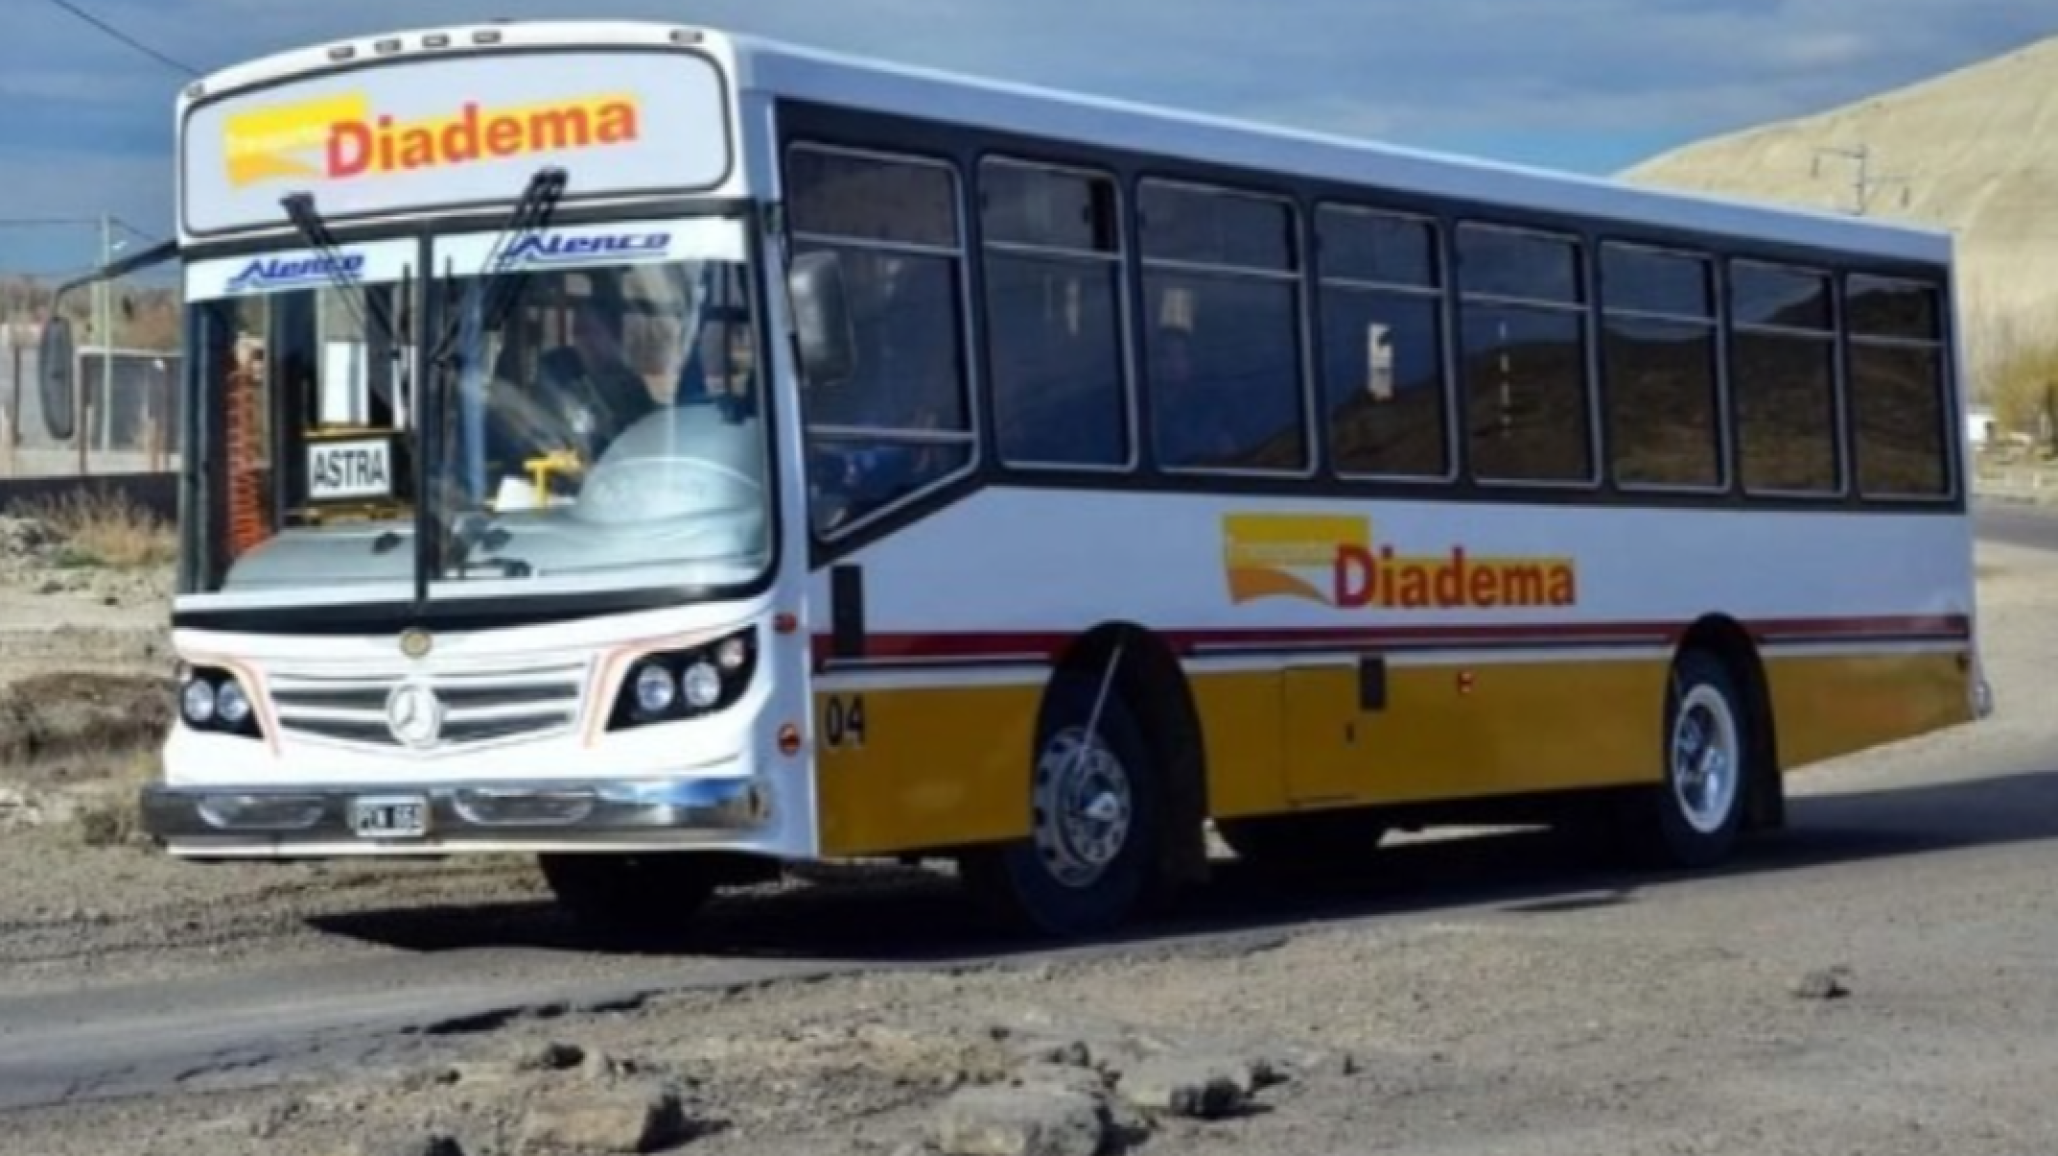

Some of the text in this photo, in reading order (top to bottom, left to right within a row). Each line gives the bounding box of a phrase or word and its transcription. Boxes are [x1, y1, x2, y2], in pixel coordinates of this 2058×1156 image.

[325, 101, 638, 178] Diadema
[502, 231, 671, 263] Alenco
[313, 448, 387, 489] ASTRA
[1334, 544, 1575, 608] Diadema
[825, 693, 865, 748] 04
